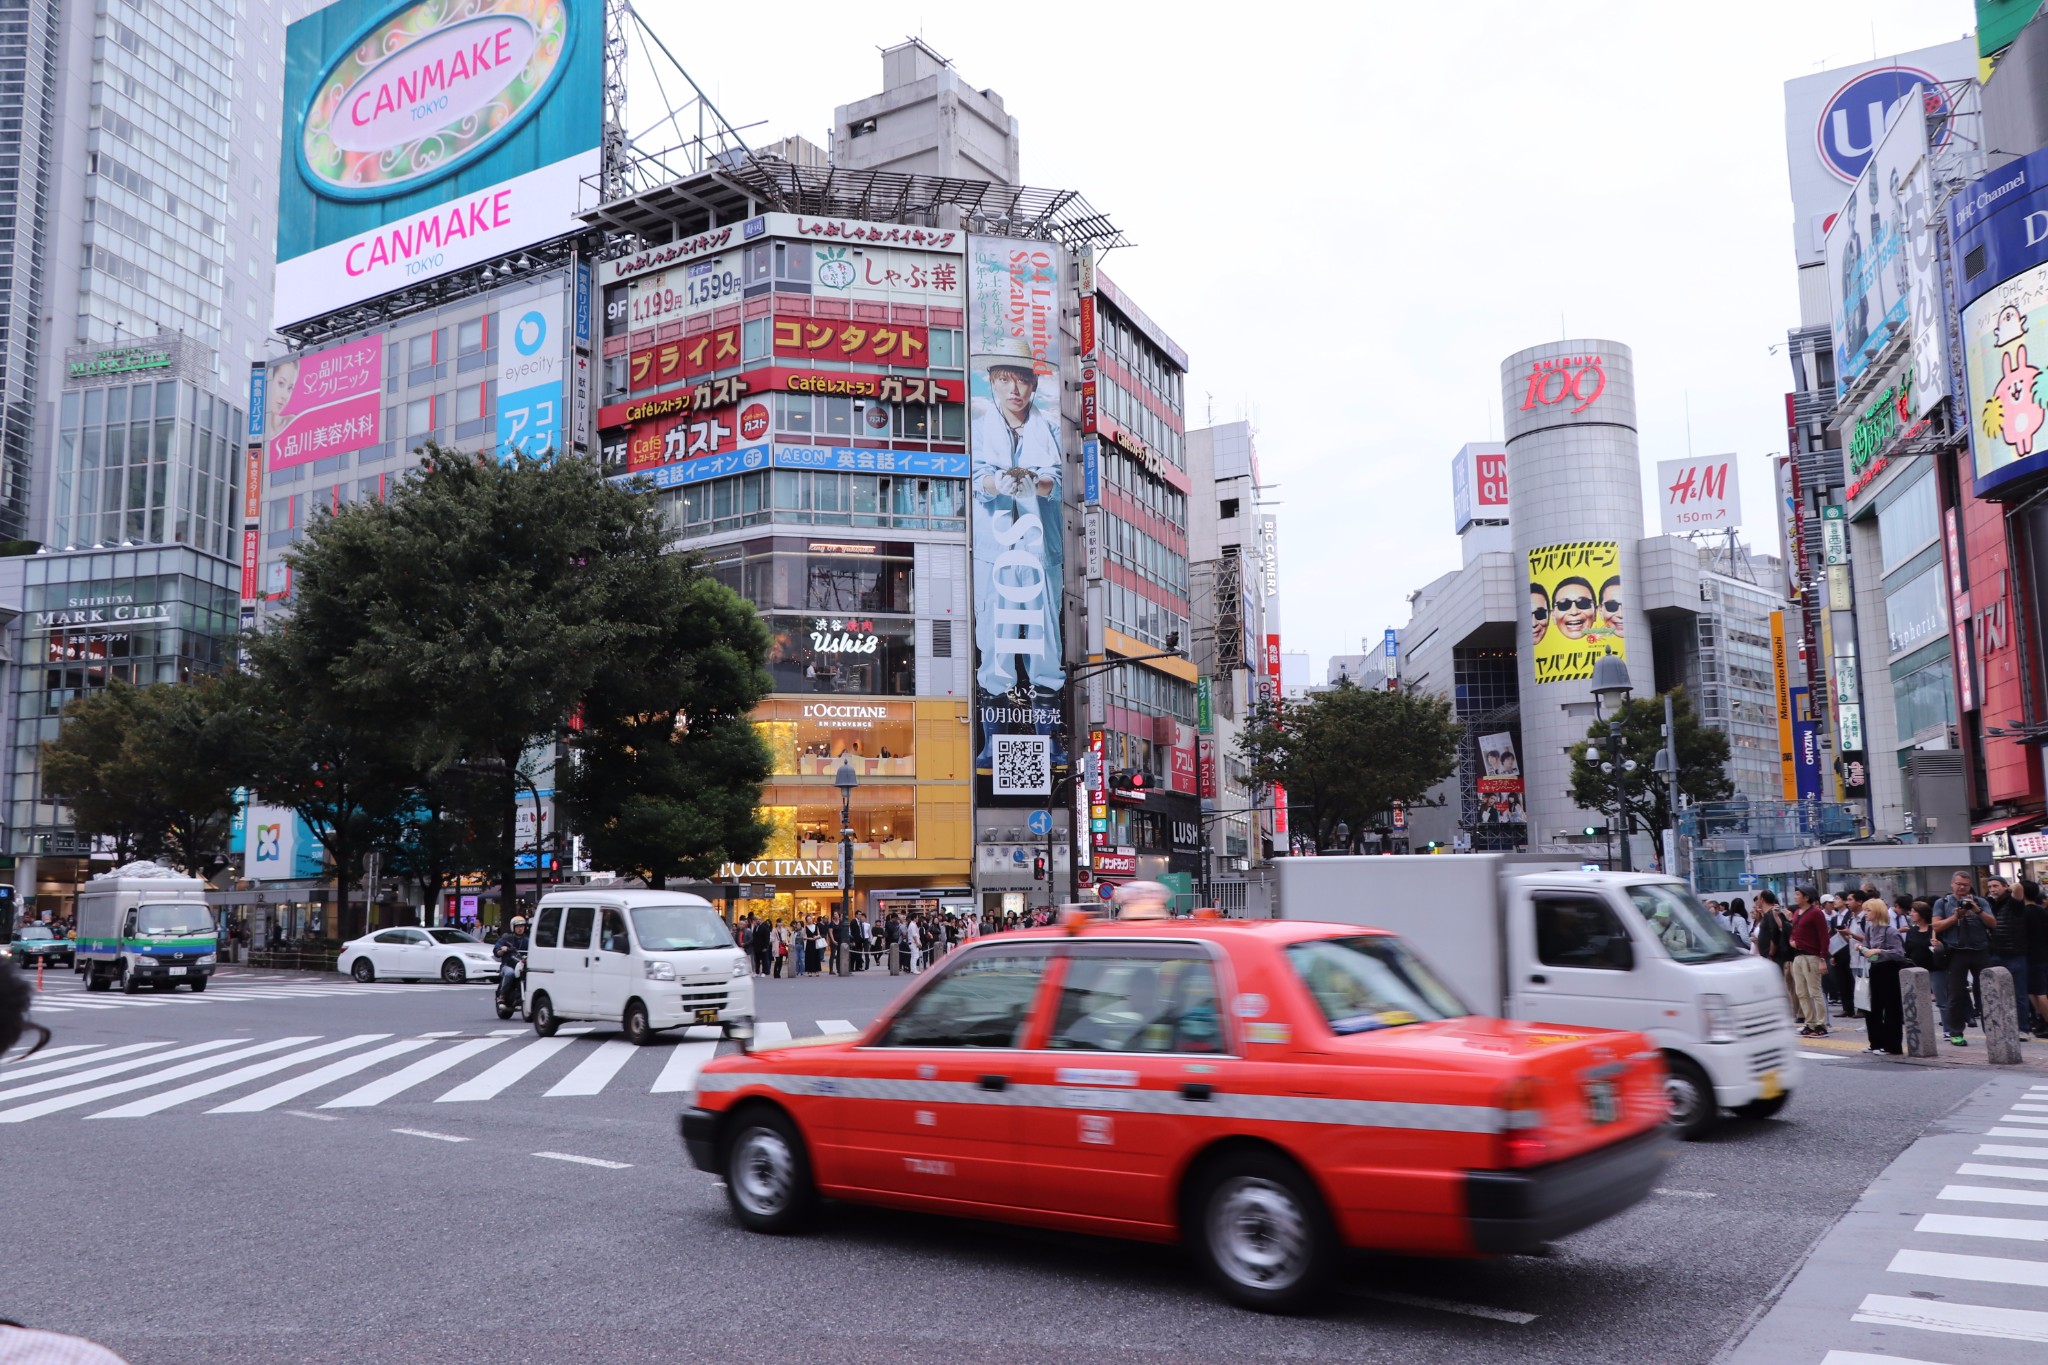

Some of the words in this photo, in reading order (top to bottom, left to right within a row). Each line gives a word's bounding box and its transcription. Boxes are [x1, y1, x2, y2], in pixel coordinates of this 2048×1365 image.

[351, 28, 512, 127] CANMAKE
[410, 96, 448, 122] TOKYO
[1956, 202, 1976, 227] DHC
[1977, 171, 2025, 210] Channel
[345, 189, 512, 277] CANMAKE
[797, 217, 956, 248] しゃぶしゃぶバイキング
[405, 253, 444, 277] TOKYO
[616, 228, 732, 276] しゃぶしゃぶバイキング
[865, 257, 957, 292] しゃぶ葉
[578, 273, 589, 335] 東急リバブル
[1005, 250, 1031, 337] Sazabys
[607, 300, 627, 320] 9F
[774, 322, 925, 357] コンタクト
[1031, 289, 1053, 375] Limited
[69, 359, 120, 373] MARK
[125, 351, 170, 366] CITY
[318, 348, 377, 380] 品川スキン
[505, 355, 554, 383] eyecity
[631, 330, 739, 382] プライス
[1533, 355, 1603, 372] SHIBUYA
[317, 369, 369, 398] クリニック
[693, 376, 748, 412] ガスト
[880, 375, 949, 405] ガスト
[1520, 364, 1607, 415] 109
[251, 379, 262, 432] 東急リバブル
[577, 376, 586, 434] 献血ルーム
[868, 415, 887, 423] ガスト
[1084, 396, 1095, 427] ガスト
[284, 413, 375, 459] 品川美容外科
[663, 418, 732, 464] ガスト
[743, 419, 767, 432] ガスト
[603, 443, 628, 466] 7F
[633, 435, 662, 455] Café
[781, 447, 826, 465] AEON
[837, 450, 967, 473] 英会話イーオン
[1668, 463, 1729, 505] H&M
[1088, 519, 1098, 574] 渋谷駅前ビル
[1264, 521, 1274, 542] BIC
[1265, 547, 1277, 597] CAMERA
[1529, 549, 1618, 576] ヤバババーン
[68, 595, 134, 608] SHIBUYA
[992, 509, 1046, 680] SOIL
[34, 609, 104, 626] MARK
[114, 604, 172, 620] CITY
[816, 618, 843, 632] 渋谷
[846, 619, 874, 633] 焼肉
[810, 632, 879, 654] Ushi8
[1890, 612, 1937, 652] Euphoria
[1774, 636, 1784, 668] KiYoshi
[1777, 668, 1789, 720] Matsumoto
[803, 703, 887, 719] L'OCCITANE
[979, 707, 1062, 725] 10月10日発売
[1175, 751, 1194, 772] アコム
[1803, 730, 1814, 766] MIZUHO
[1200, 763, 1210, 786] アコム
[1172, 821, 1199, 846] LUSH
